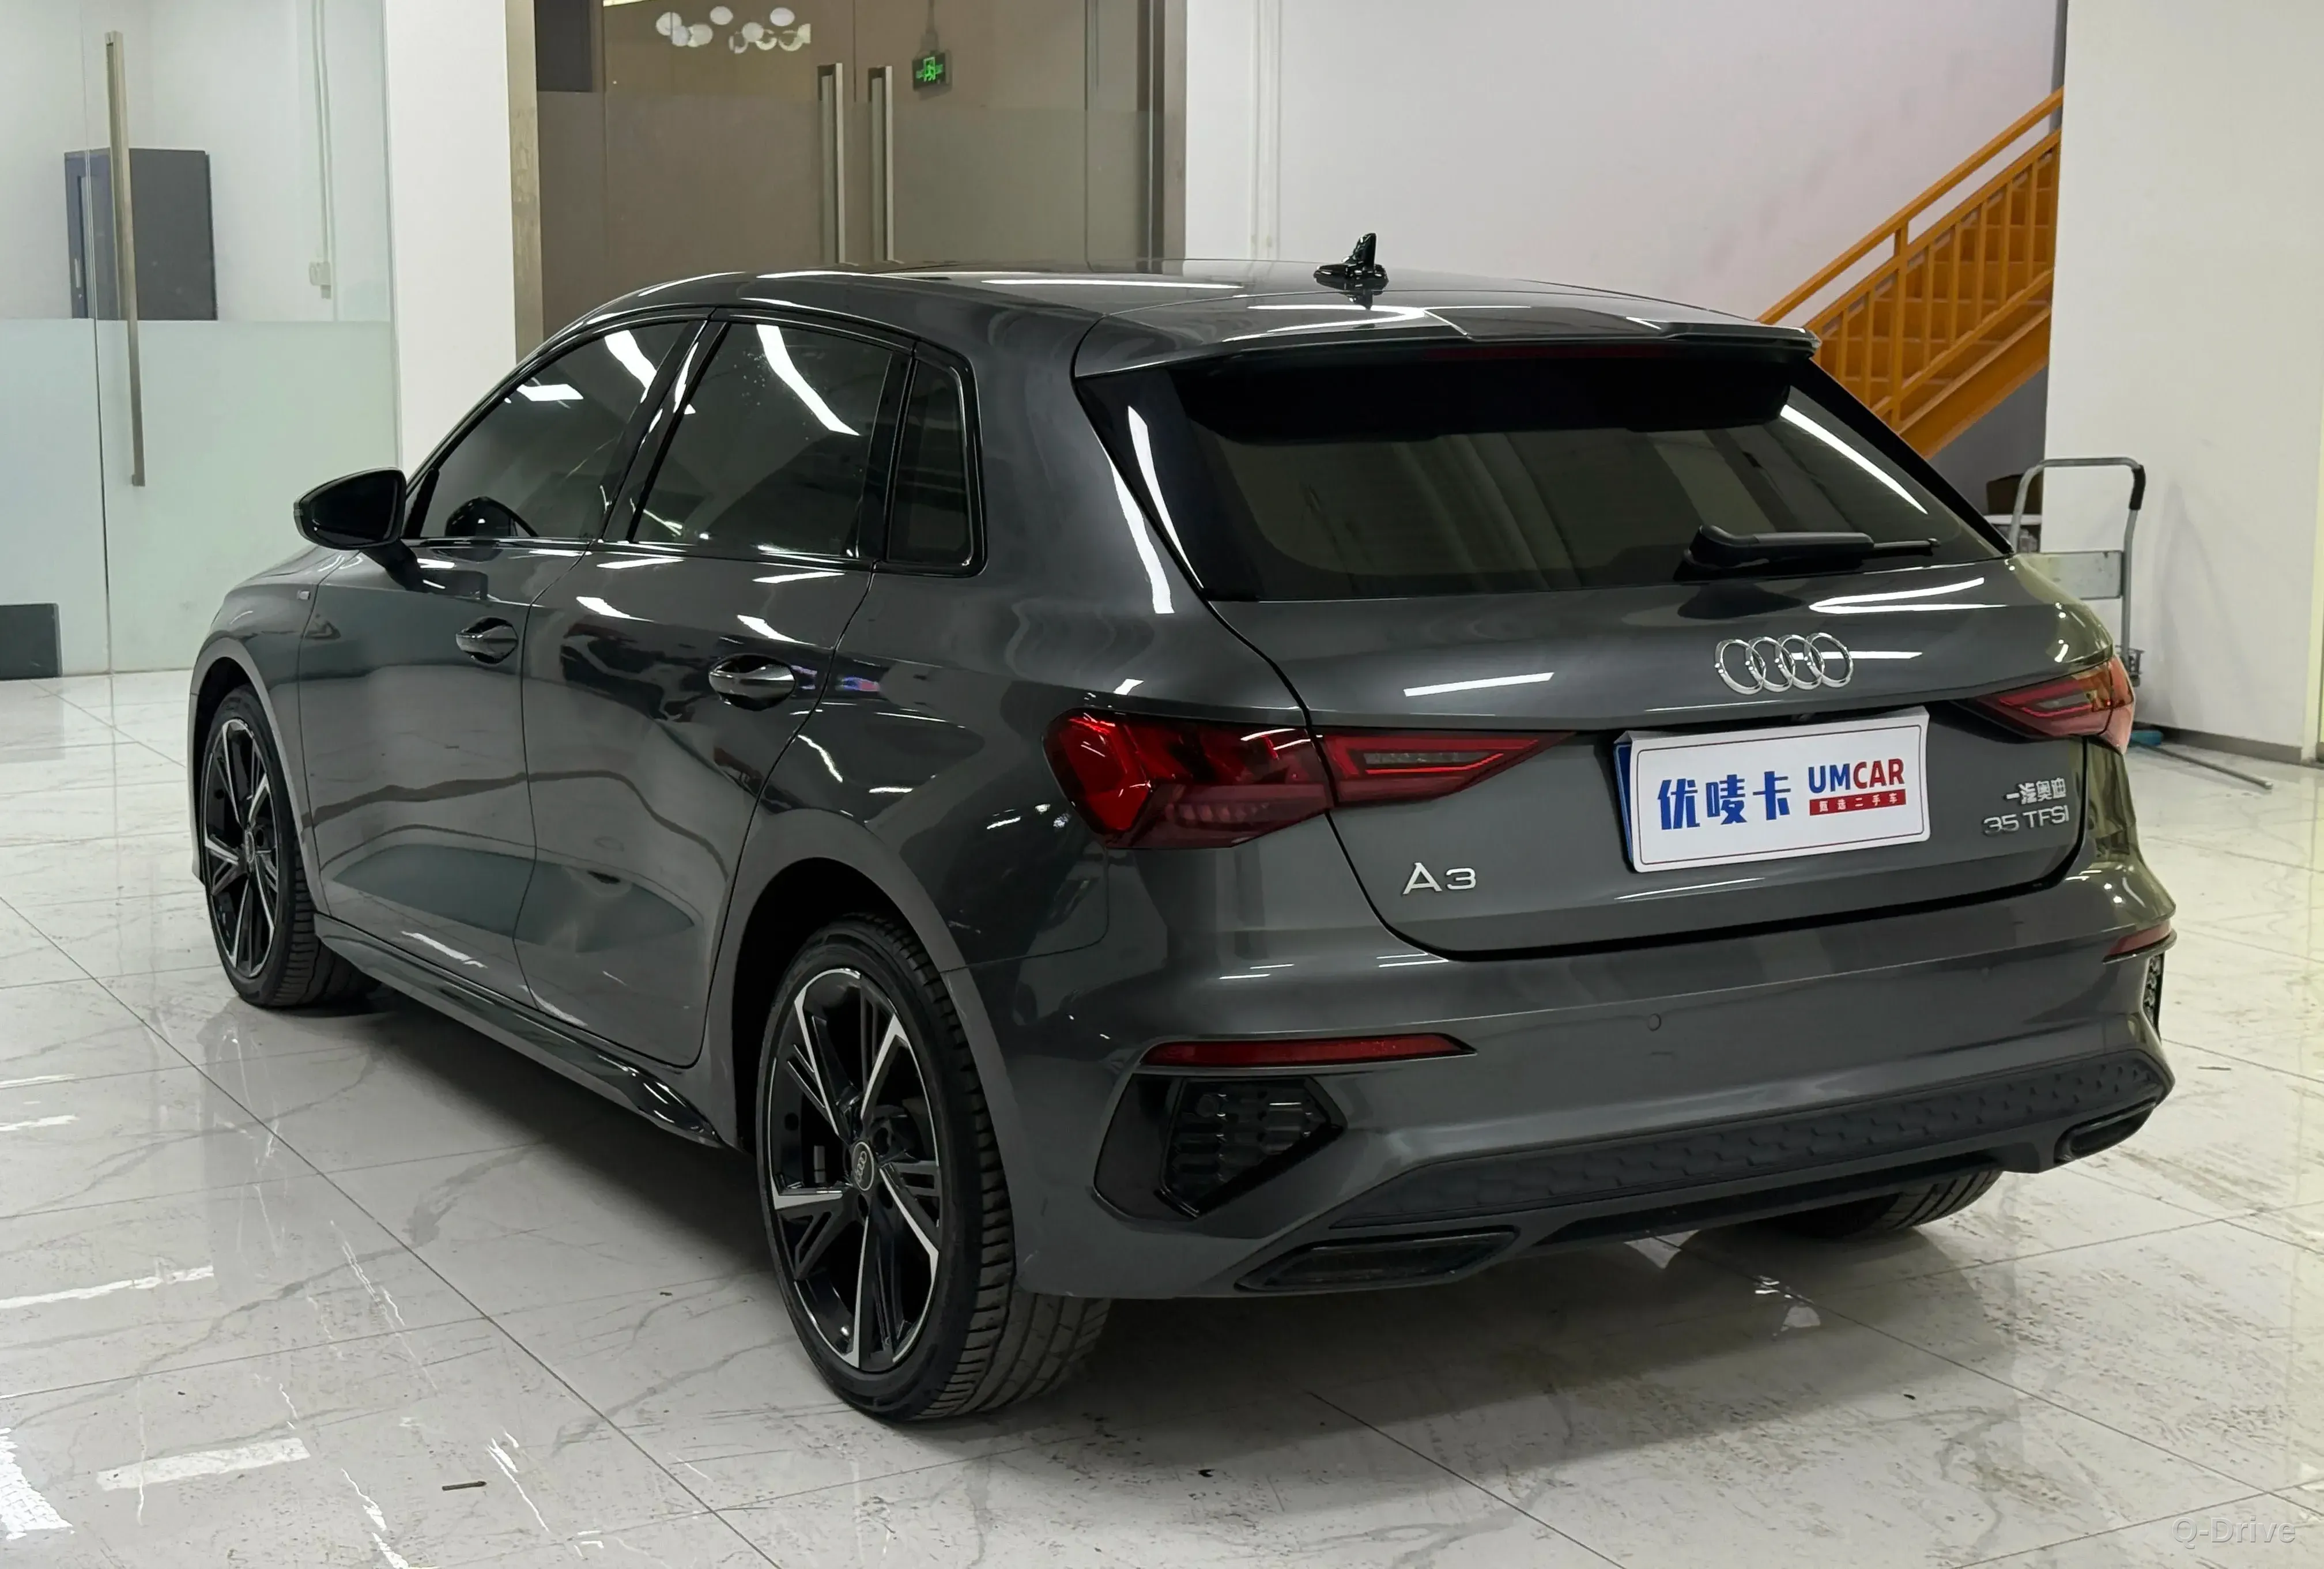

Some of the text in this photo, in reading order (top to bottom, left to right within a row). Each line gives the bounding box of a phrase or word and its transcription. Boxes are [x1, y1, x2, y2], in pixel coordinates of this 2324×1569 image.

[1808, 758, 1904, 793] UMCAR
[1657, 771, 1791, 830] 优唛卡
[1983, 805, 2070, 835] 35 TFSI
[1402, 862, 1477, 895] A3
